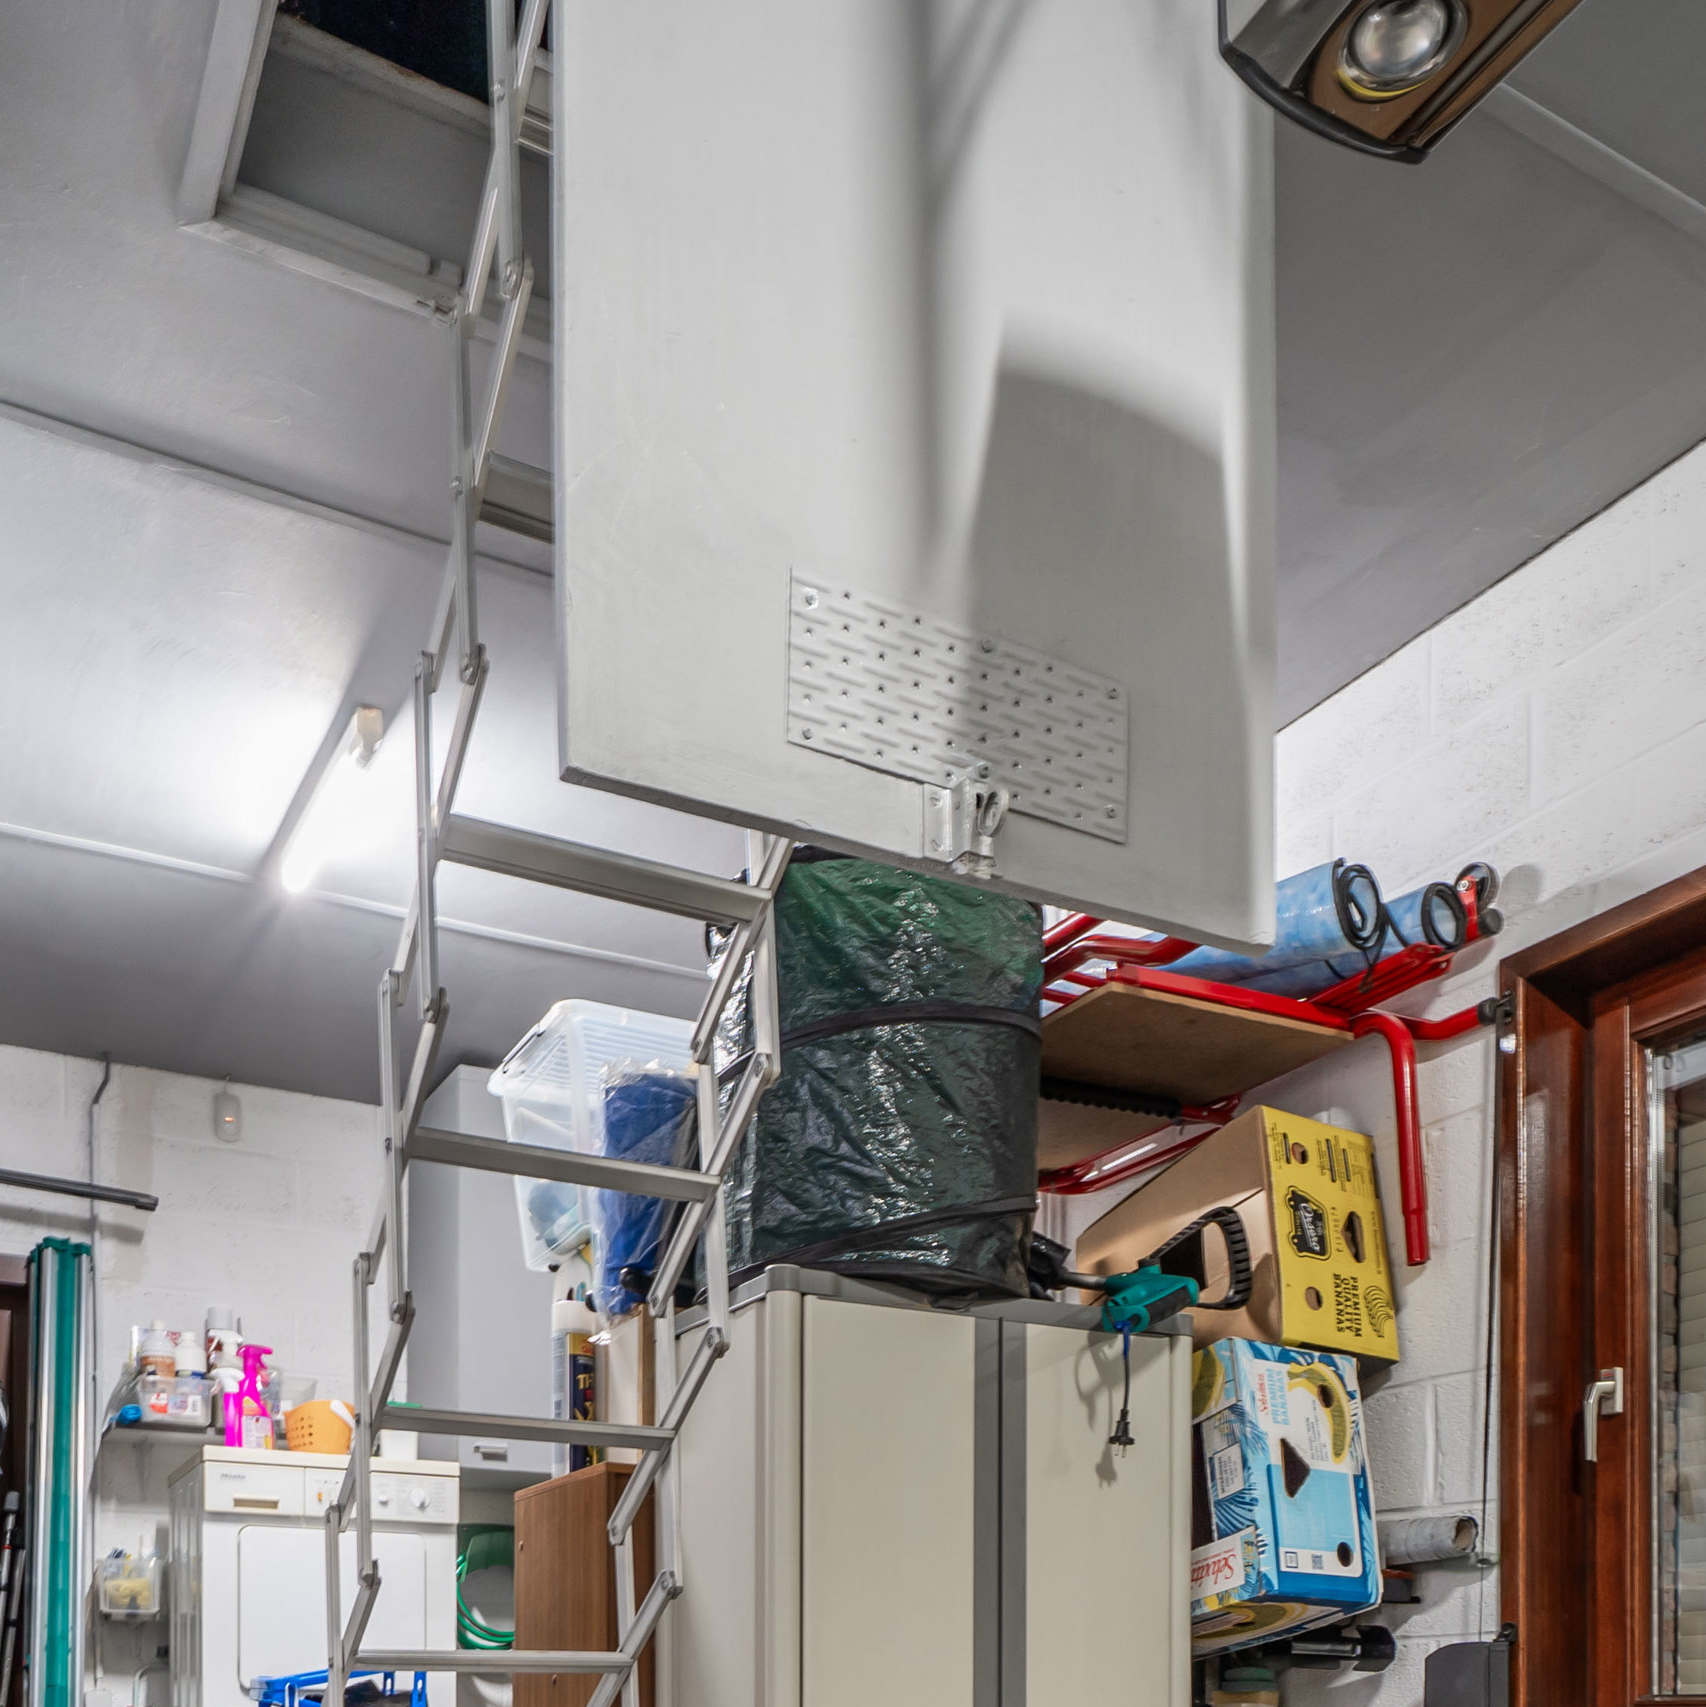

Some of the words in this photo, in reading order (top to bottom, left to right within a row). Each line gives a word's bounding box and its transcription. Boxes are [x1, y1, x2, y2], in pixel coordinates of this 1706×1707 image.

[1332, 1273, 1344, 1334] BANANAS
[1341, 1277, 1355, 1334] QUALITY
[1349, 1276, 1364, 1338] PREMIUM
[1266, 1368, 1281, 1425] PREMIUM
